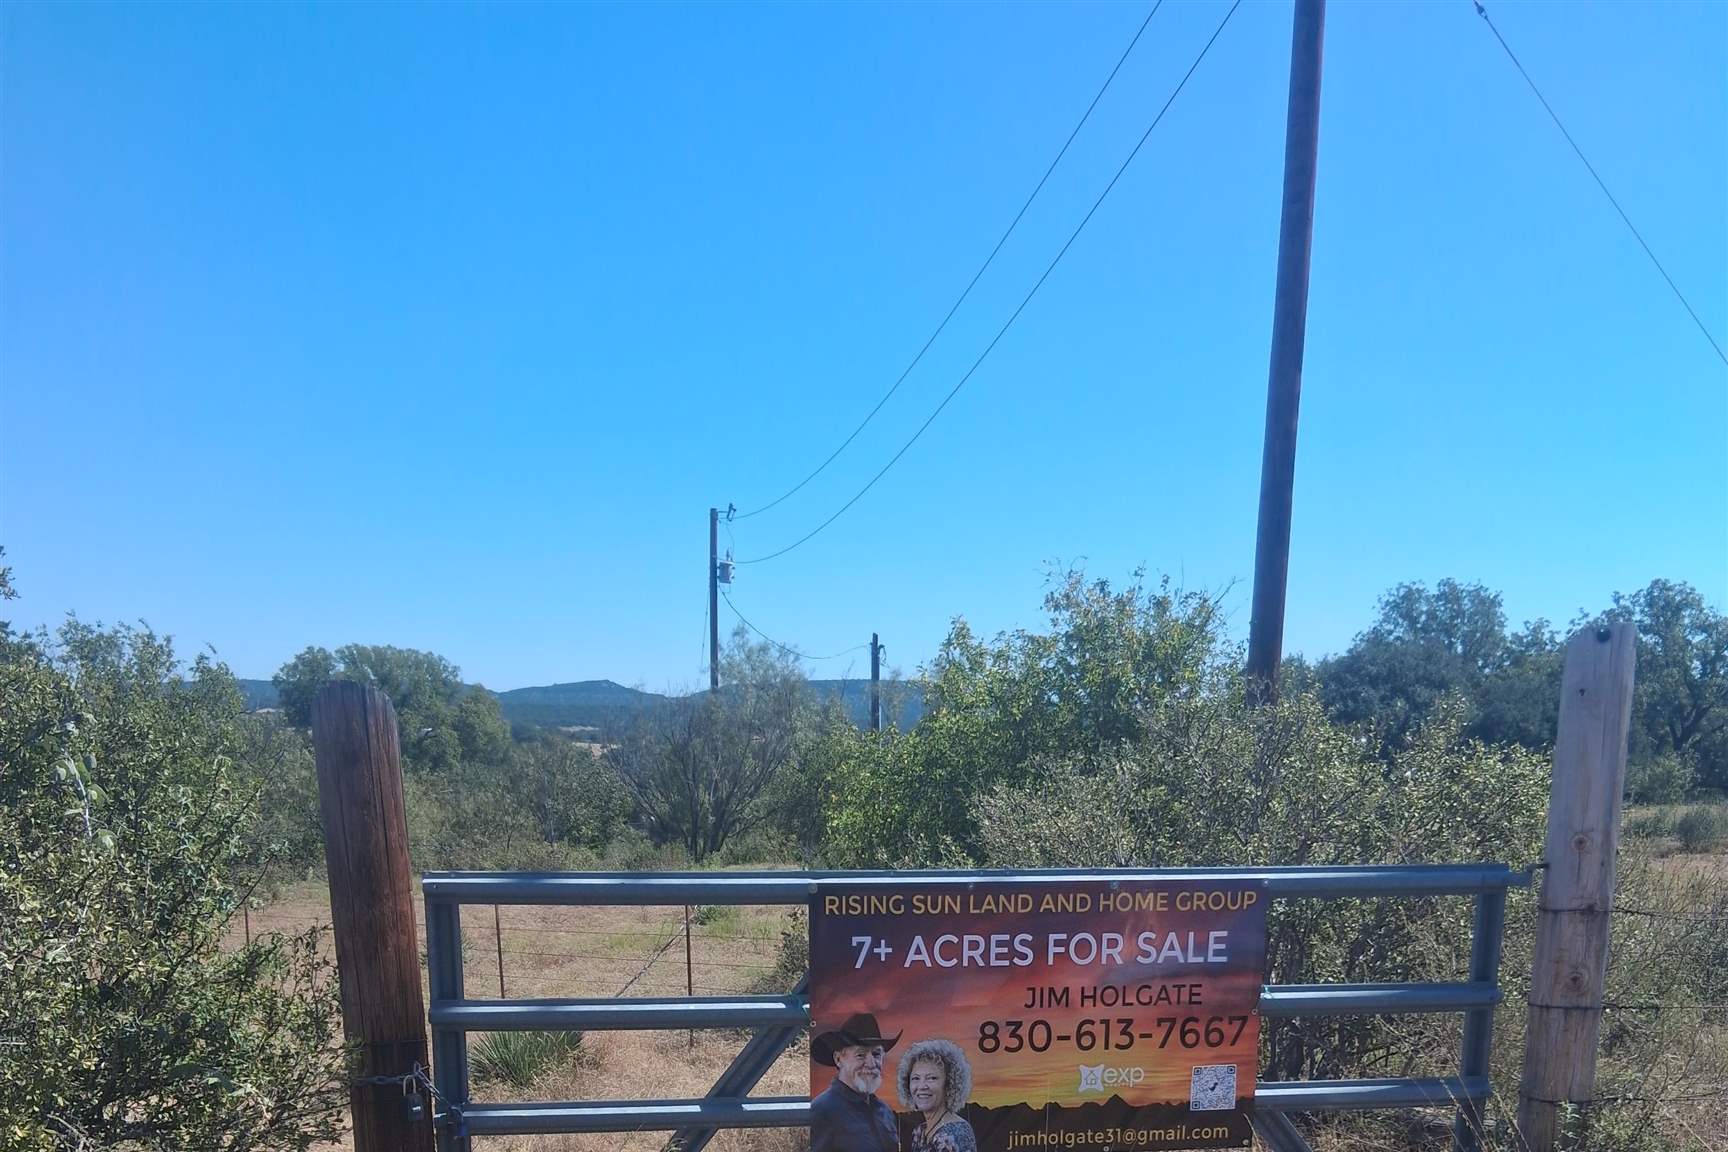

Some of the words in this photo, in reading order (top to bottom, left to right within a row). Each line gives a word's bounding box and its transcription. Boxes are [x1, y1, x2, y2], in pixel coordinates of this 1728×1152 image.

[825, 895, 905, 915] RISING
[912, 894, 961, 915] SUN
[969, 894, 1033, 914] LAND
[1039, 893, 1092, 913] AND
[1100, 892, 1169, 912] HOME
[1176, 891, 1257, 911] GROUP
[851, 936, 893, 969] 7+
[903, 933, 1034, 968] ACRES
[1047, 932, 1124, 966] FOR
[1136, 930, 1229, 964] SALE
[1024, 986, 1070, 1009] JIM
[1080, 983, 1203, 1008] HOLGATE
[978, 1015, 1249, 1053] 830-613-7667
[1007, 1125, 1229, 1150] jimholgate31@gmail.com
